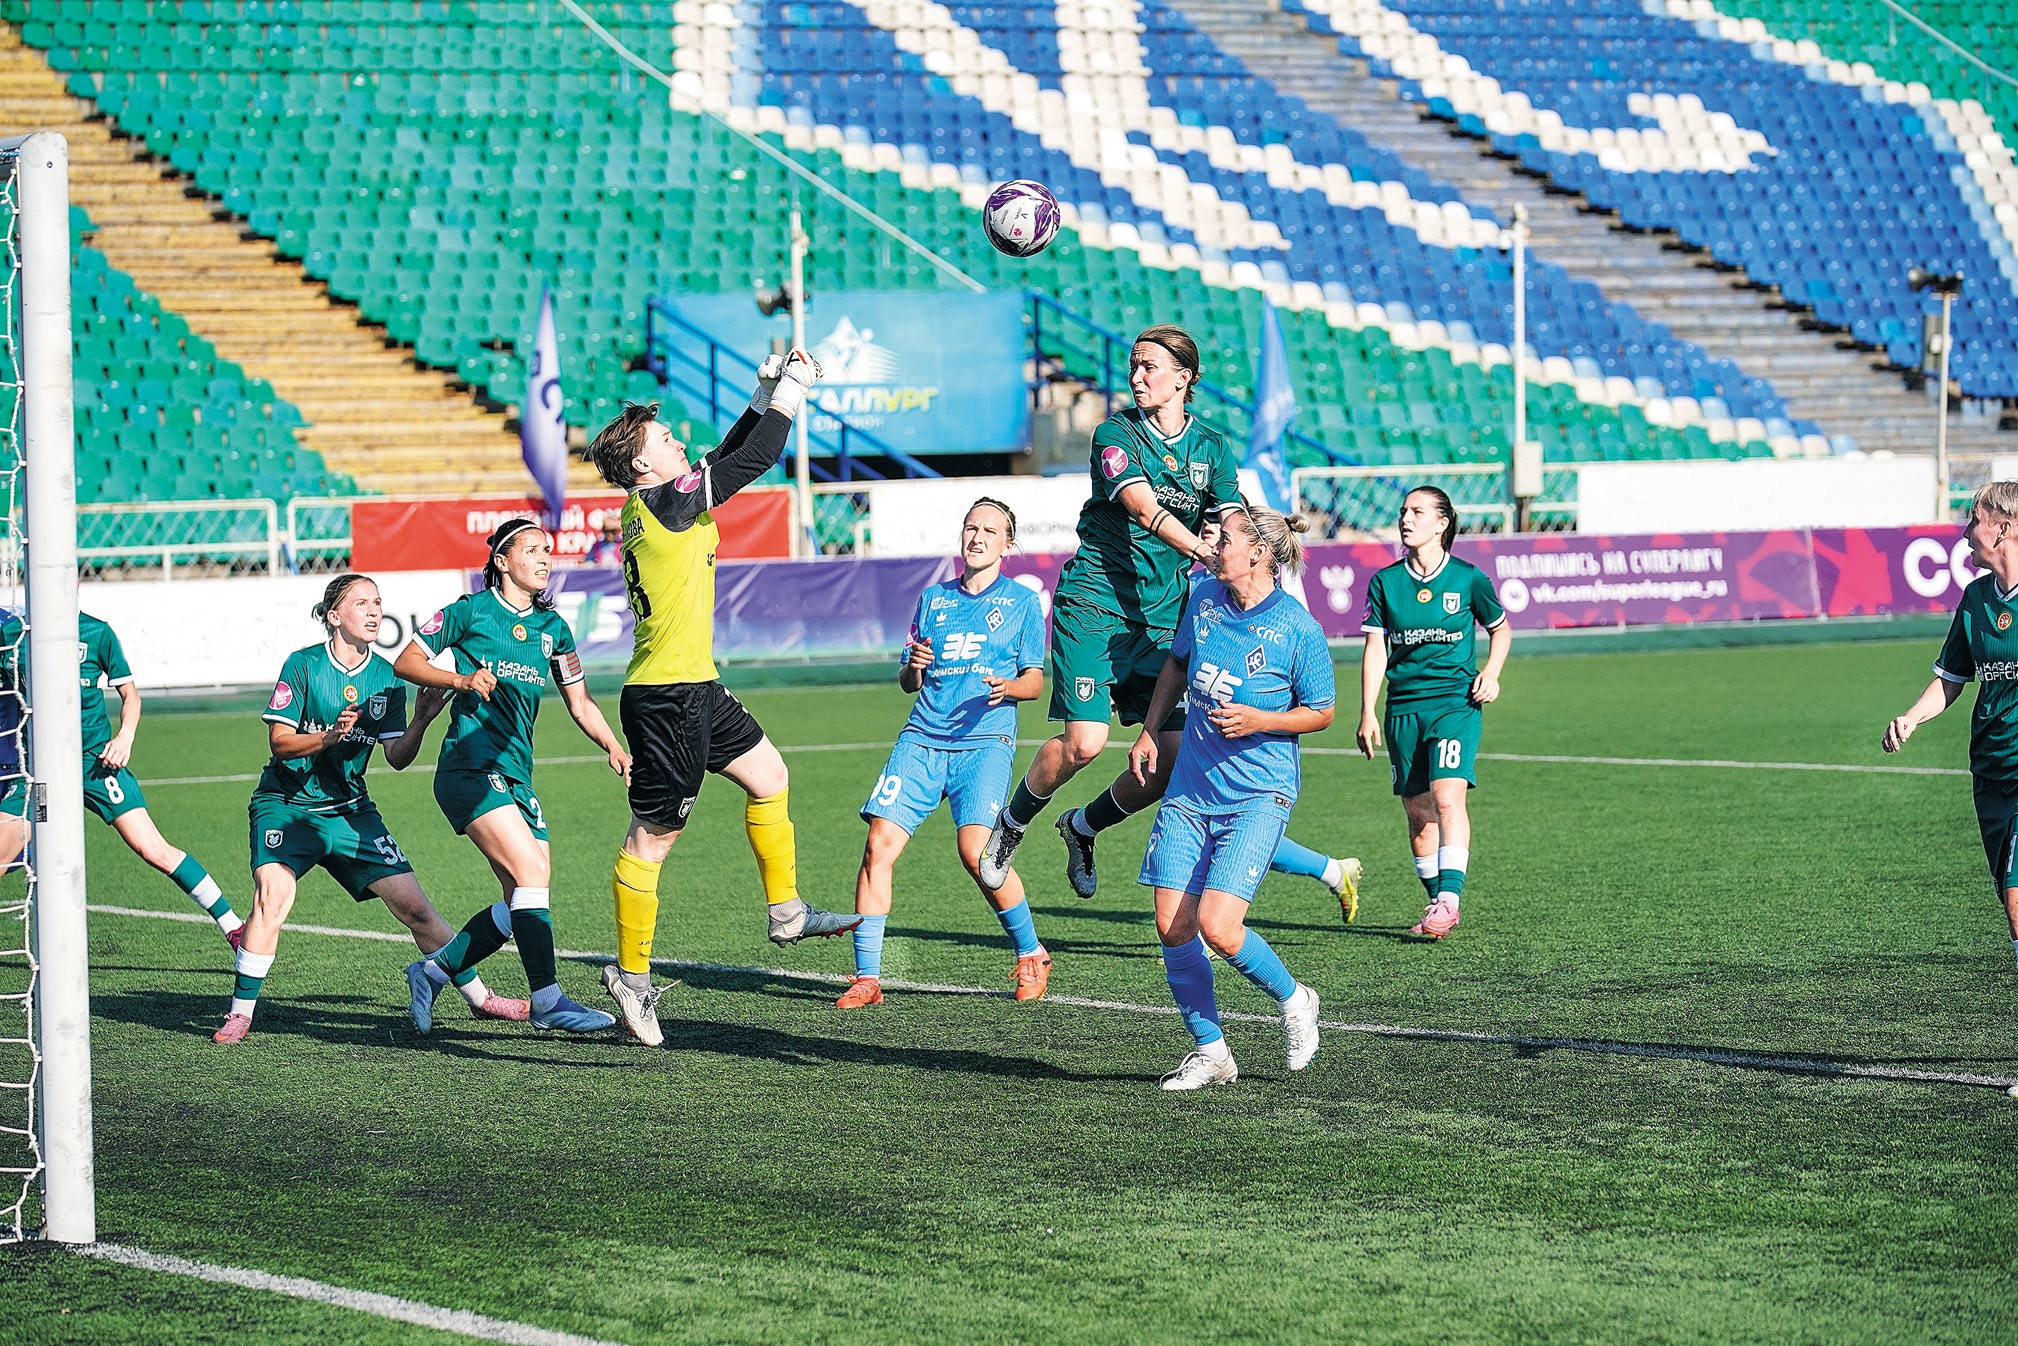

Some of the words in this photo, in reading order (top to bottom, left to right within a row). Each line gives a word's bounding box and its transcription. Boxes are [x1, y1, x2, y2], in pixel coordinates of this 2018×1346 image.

[1153, 484, 1196, 502] КАЗАНЬ
[1404, 628, 1447, 638] КАЗАНЬ
[1404, 632, 1464, 646] ОРГСИНТЕЗ
[498, 660, 539, 676] КАЗАНЬ
[1437, 739, 1461, 769] 18
[104, 775, 125, 805] 8
